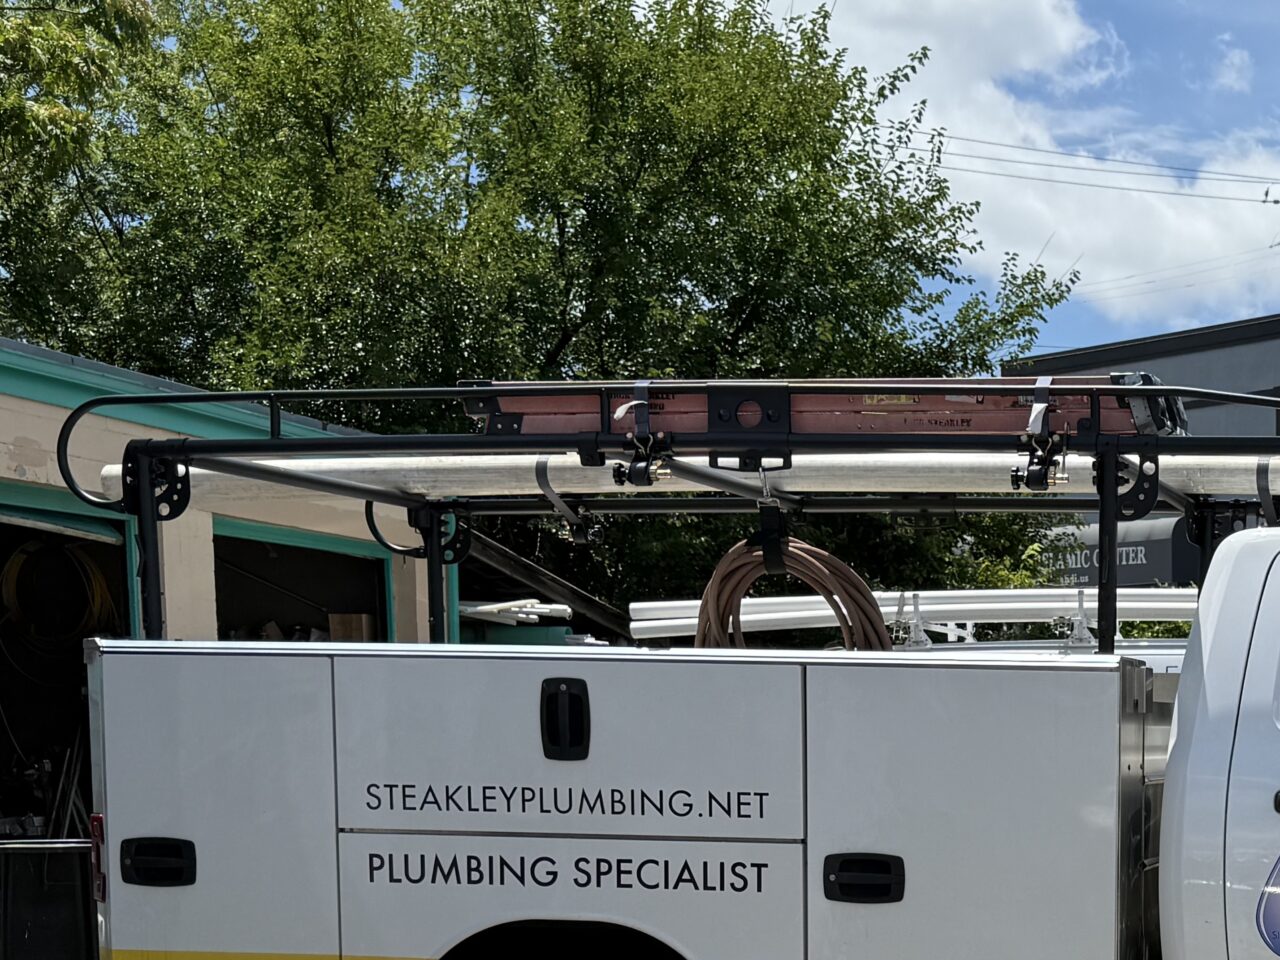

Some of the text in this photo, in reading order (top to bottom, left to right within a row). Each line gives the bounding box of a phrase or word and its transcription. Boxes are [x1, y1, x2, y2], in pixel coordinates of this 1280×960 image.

[1093, 547, 1146, 567] CTER
[365, 783, 769, 818] STEAKLEYPLUMBING.NET
[368, 853, 769, 893] PLUMBING SPECIALIST
